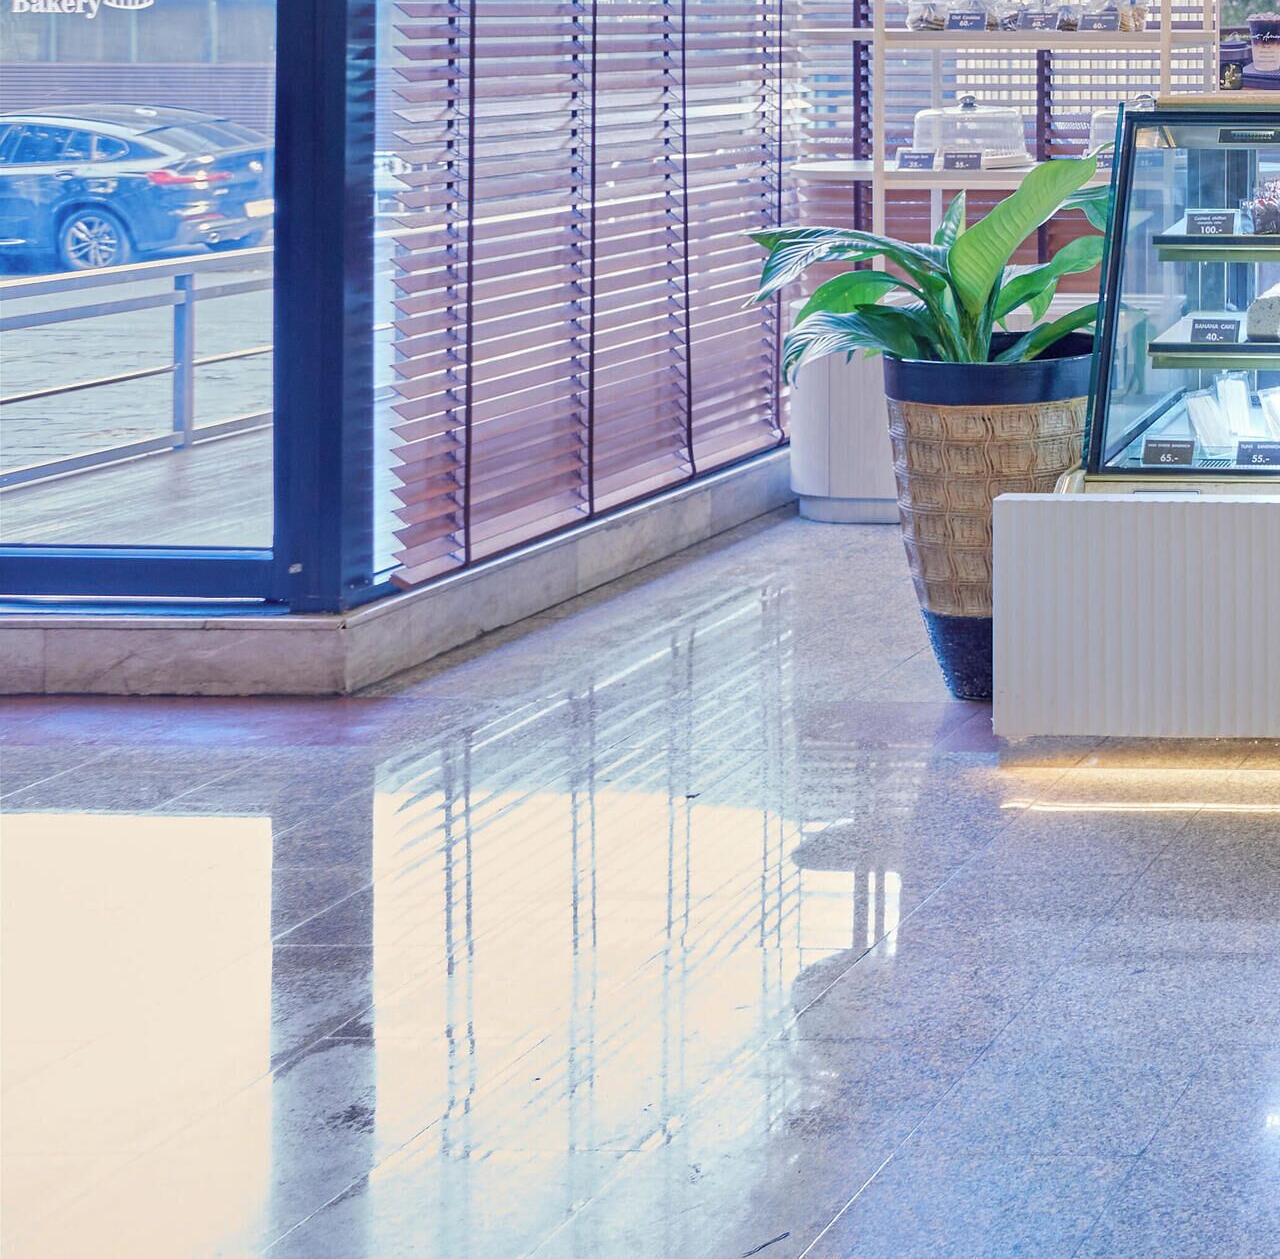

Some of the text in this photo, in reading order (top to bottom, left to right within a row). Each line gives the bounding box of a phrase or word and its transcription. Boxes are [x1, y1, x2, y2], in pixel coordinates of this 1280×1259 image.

[1200, 226, 1223, 234] 100.-
[1206, 333, 1224, 341] 40.-
[1160, 453, 1179, 463] 65.-
[1251, 454, 1271, 463] 55.-
